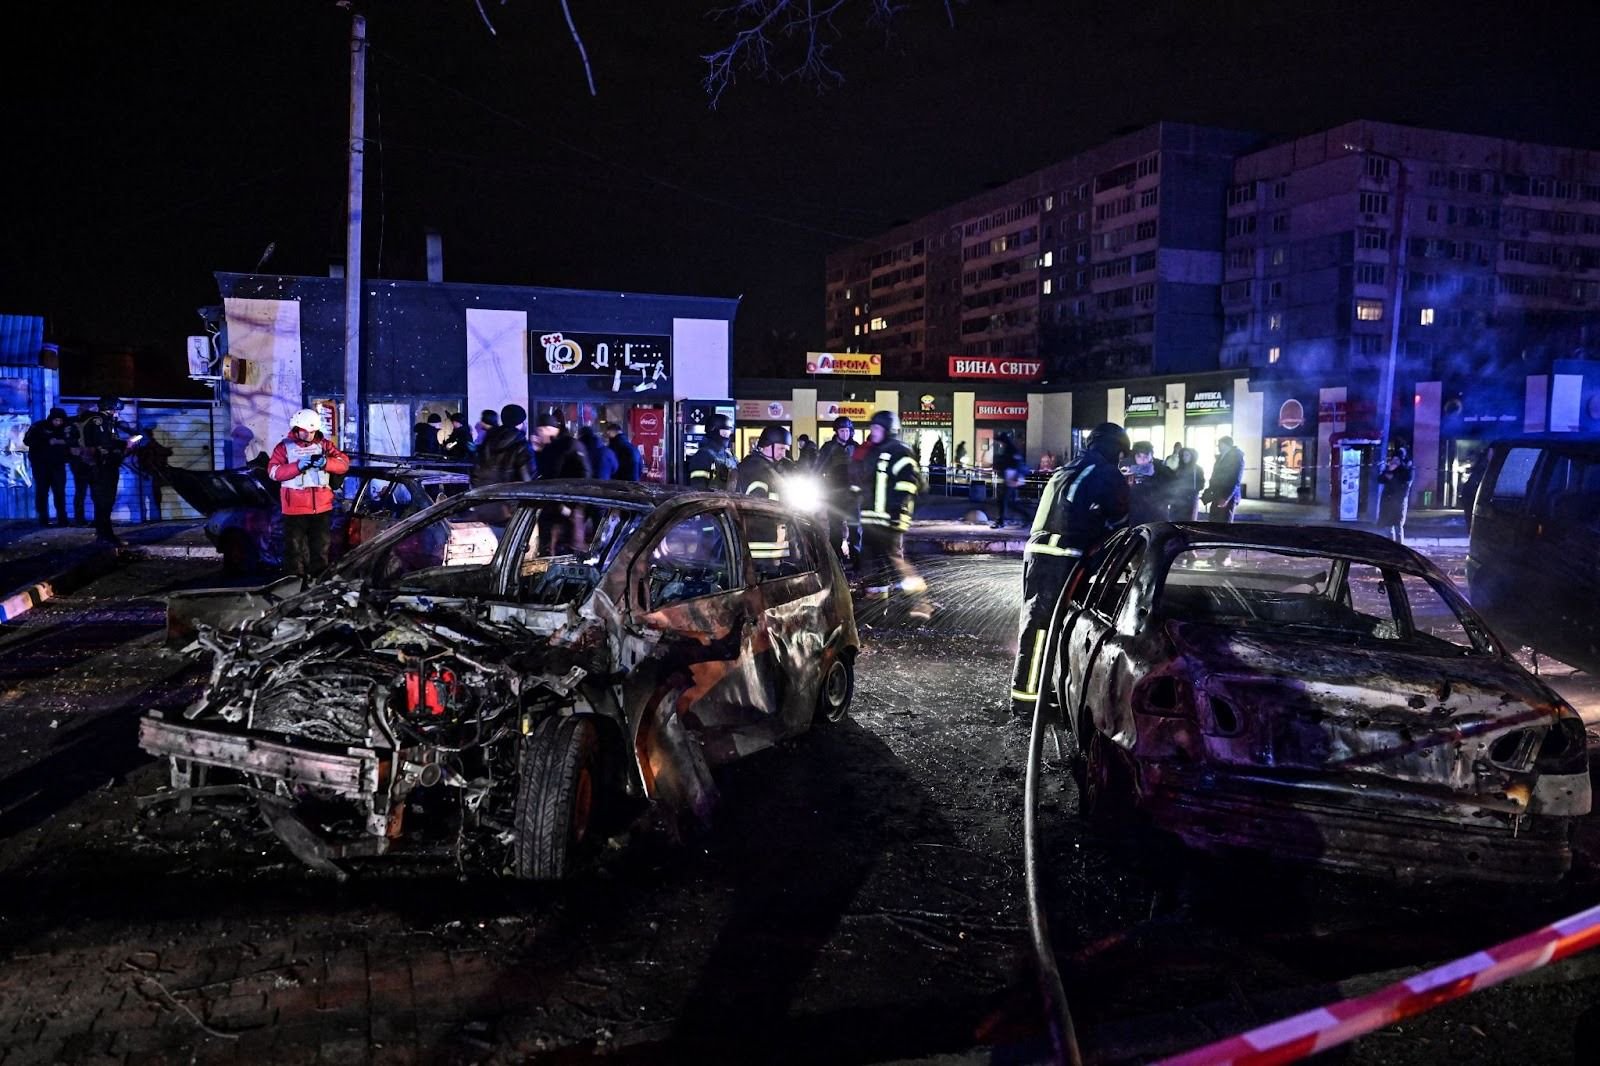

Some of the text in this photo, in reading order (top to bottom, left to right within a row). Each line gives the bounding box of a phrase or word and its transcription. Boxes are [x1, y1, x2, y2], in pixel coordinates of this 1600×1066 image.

[549, 343, 573, 363] IQ
[956, 360, 1041, 375] ВИНА СВІТУ
[1194, 392, 1222, 401] АПТЕКА
[979, 406, 1028, 415] ВИНА СВІТУ
